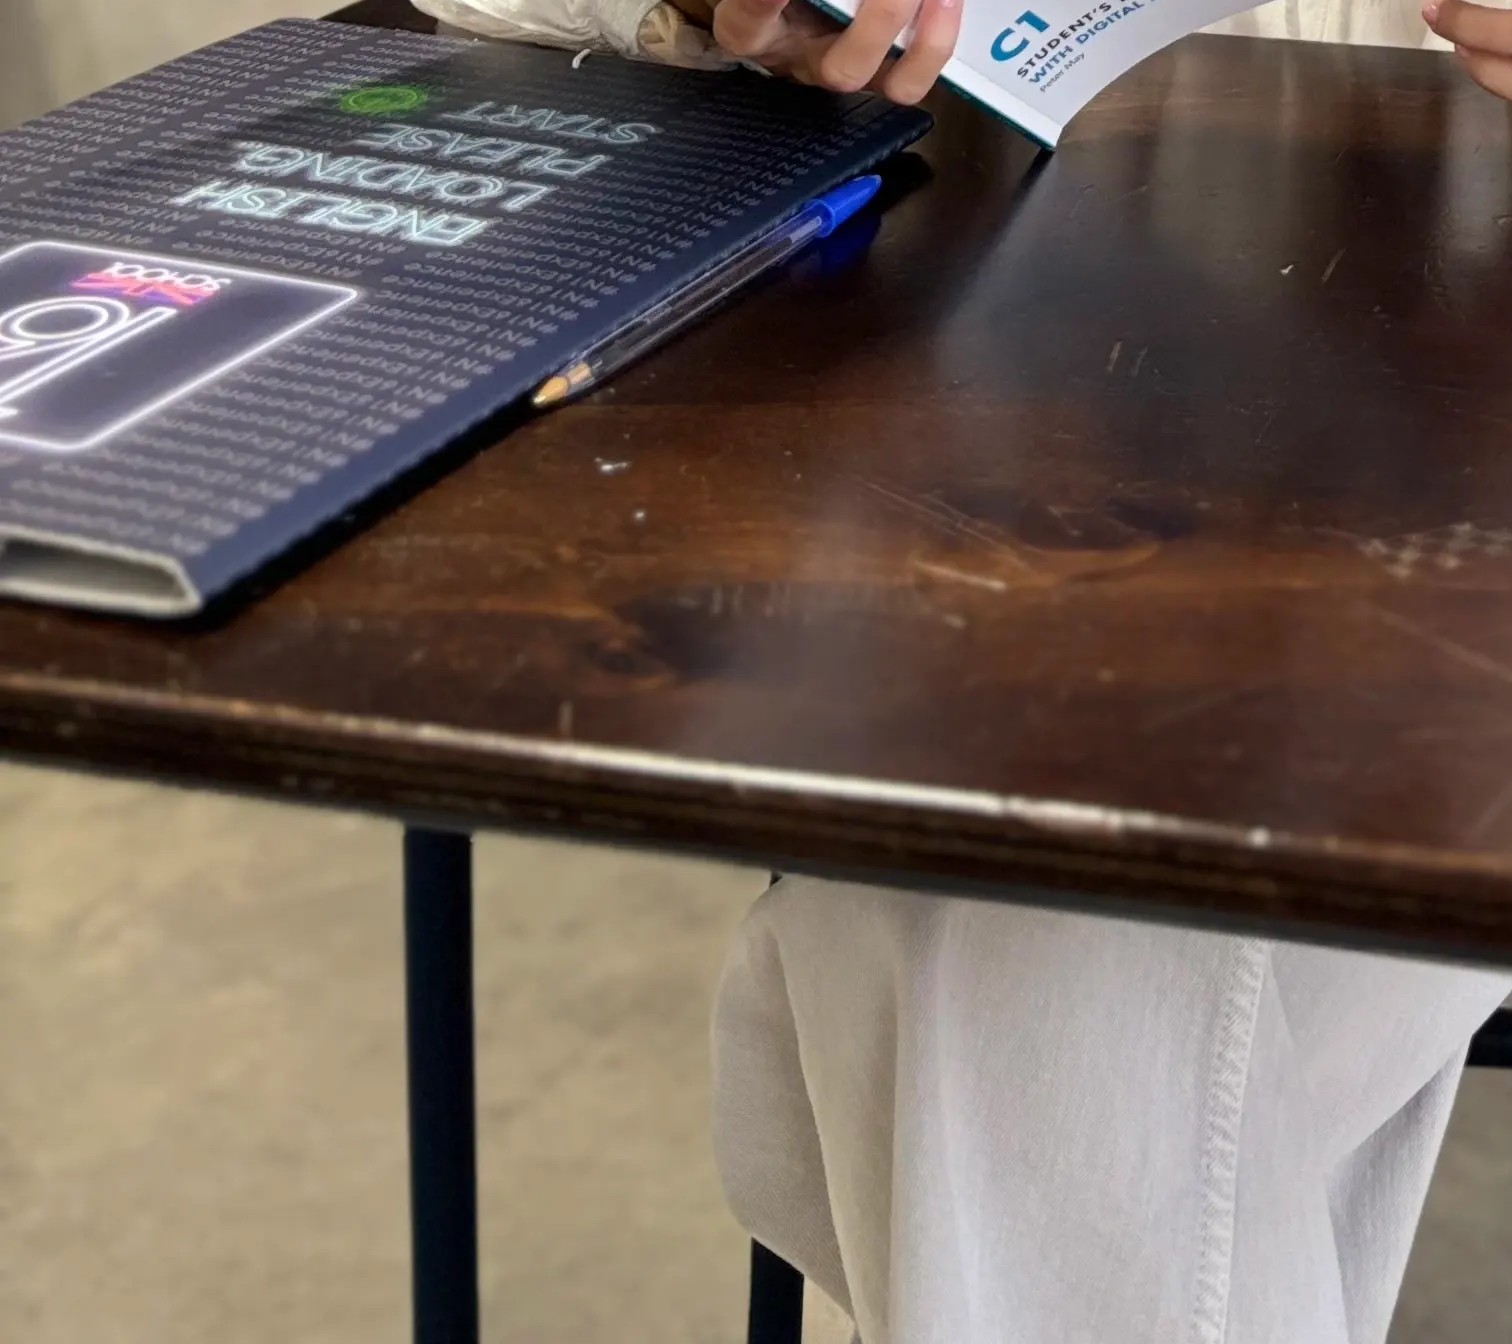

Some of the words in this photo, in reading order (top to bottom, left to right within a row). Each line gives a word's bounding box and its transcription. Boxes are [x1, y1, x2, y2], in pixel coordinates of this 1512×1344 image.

[990, 9, 1051, 62] C1
[1028, 45, 1074, 84] WITH
[1075, 0, 1145, 45] DIGITAL
[1064, 52, 1085, 70] May
[440, 100, 658, 146] START
[355, 121, 611, 177] PLEASE
[172, 178, 492, 246] ENGLISH
[535, 196, 715, 238] #N16Experienc
[553, 186, 733, 227] #N16Experienc
[572, 176, 749, 216] #N16Experienc
[476, 228, 662, 272] #N16Experienc
[515, 206, 698, 249] #N16Experienc
[400, 261, 605, 309] #N16Experience
[422, 249, 625, 297] #N16Experience
[455, 239, 643, 284] #N16Experienc
[371, 287, 566, 335] #N16Experienc
[378, 273, 585, 322] #N16Experience
[324, 312, 524, 362] #N16Experienc
[348, 300, 545, 348] #N16Experienc
[275, 339, 479, 390] #N16Experienc
[300, 325, 502, 376] #N16Experienc
[223, 367, 432, 420] #N16Experienc
[249, 353, 456, 405] #N16Experienc
[168, 397, 383, 452] #N16Experienc
[195, 382, 408, 436] #N16Experienc
[139, 412, 357, 468] #N16Experienc
